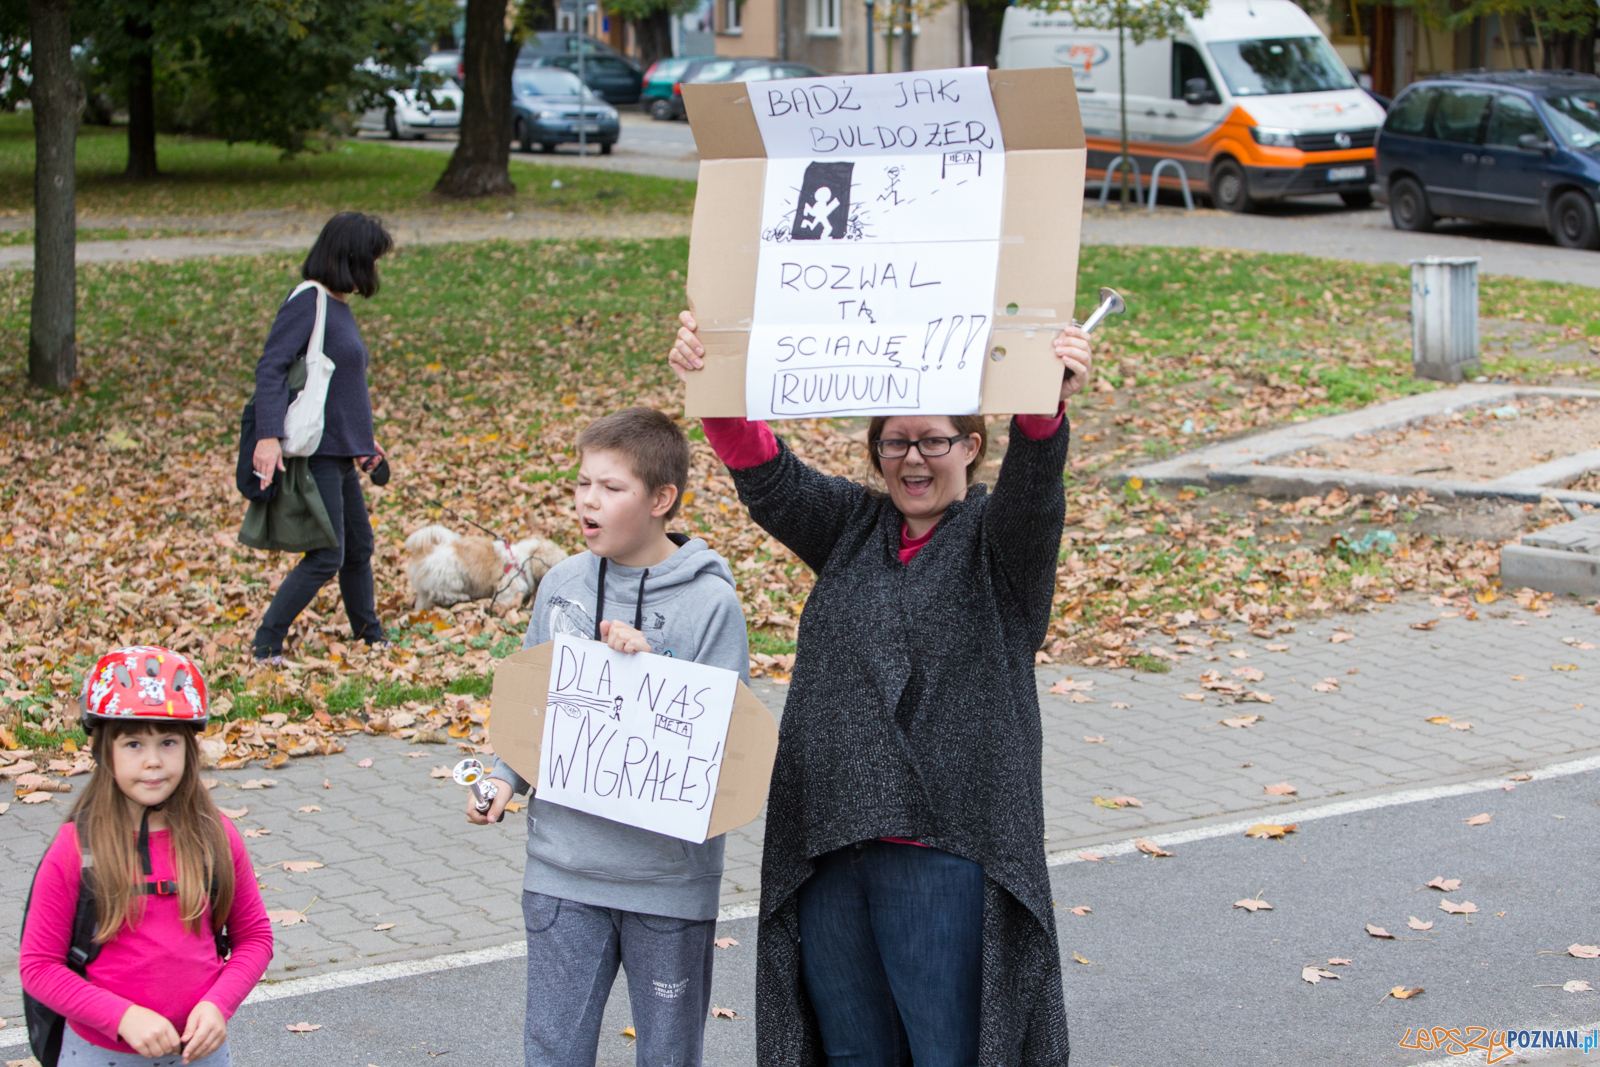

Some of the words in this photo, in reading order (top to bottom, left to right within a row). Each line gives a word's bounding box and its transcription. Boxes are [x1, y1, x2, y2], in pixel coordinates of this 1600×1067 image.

[895, 79, 960, 108] JAK
[781, 262, 941, 292] ROZWAL
[839, 300, 876, 324] TĄ
[781, 373, 908, 404] RUUUUUN
[556, 645, 611, 695] DLA
[637, 672, 711, 720] NAS
[658, 717, 688, 734] META
